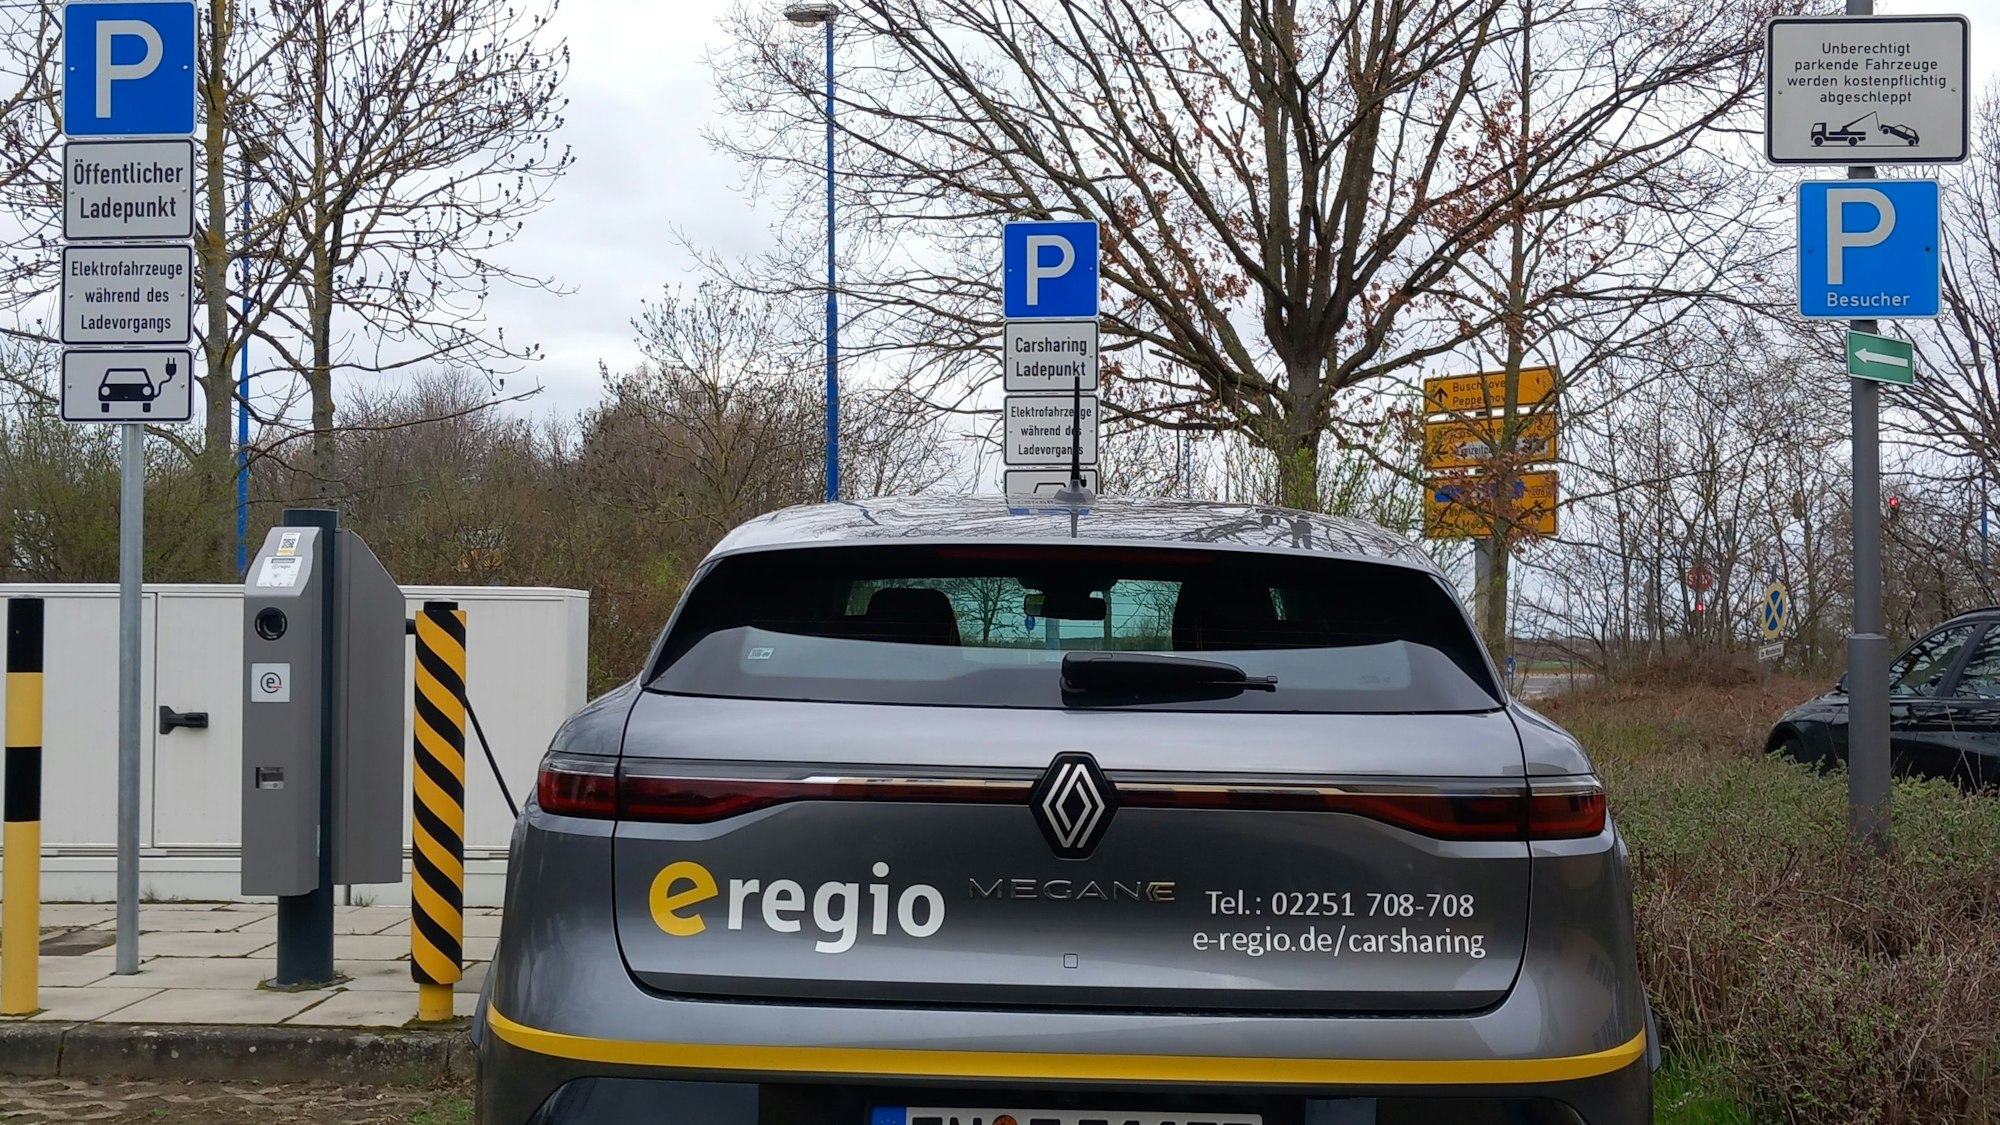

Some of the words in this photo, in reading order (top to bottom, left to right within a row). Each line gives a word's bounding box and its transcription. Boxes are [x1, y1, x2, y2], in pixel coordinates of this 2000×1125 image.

[1821, 42, 1911, 56] Unberechtigt
[95, 20, 164, 119] P
[1794, 59, 1859, 72] parkende
[1864, 58, 1938, 72] Fahrzeuge
[1787, 75, 1837, 87] werden
[1844, 74, 1947, 89] kostenpflichtig
[1819, 91, 1912, 105] abgeschleppt
[73, 159, 184, 185] Öffentlicher
[80, 195, 176, 223] Ladepunkt
[1827, 187, 1897, 285] P
[71, 260, 183, 280] Elektrofahrzeuge
[1026, 234, 1076, 306] P
[84, 287, 140, 303] während
[146, 287, 169, 303] des
[1826, 292, 1911, 307] Besucher
[81, 314, 172, 334] Ladevorgangs
[1015, 336, 1087, 356] Carsharing
[1016, 361, 1086, 380] Ladepunkt
[1453, 380, 1506, 393] Buschove
[1011, 406, 1092, 420] Elektrofahrzege
[1021, 425, 1061, 436] während
[1018, 444, 1084, 458] Ladevorgans
[969, 877, 1176, 902] MEGANE
[1206, 889, 1262, 915] Tel.:
[1271, 892, 1355, 917] 02251
[1366, 892, 1475, 918] 708-708
[1192, 925, 1486, 959] e-regio.de/carsharing
